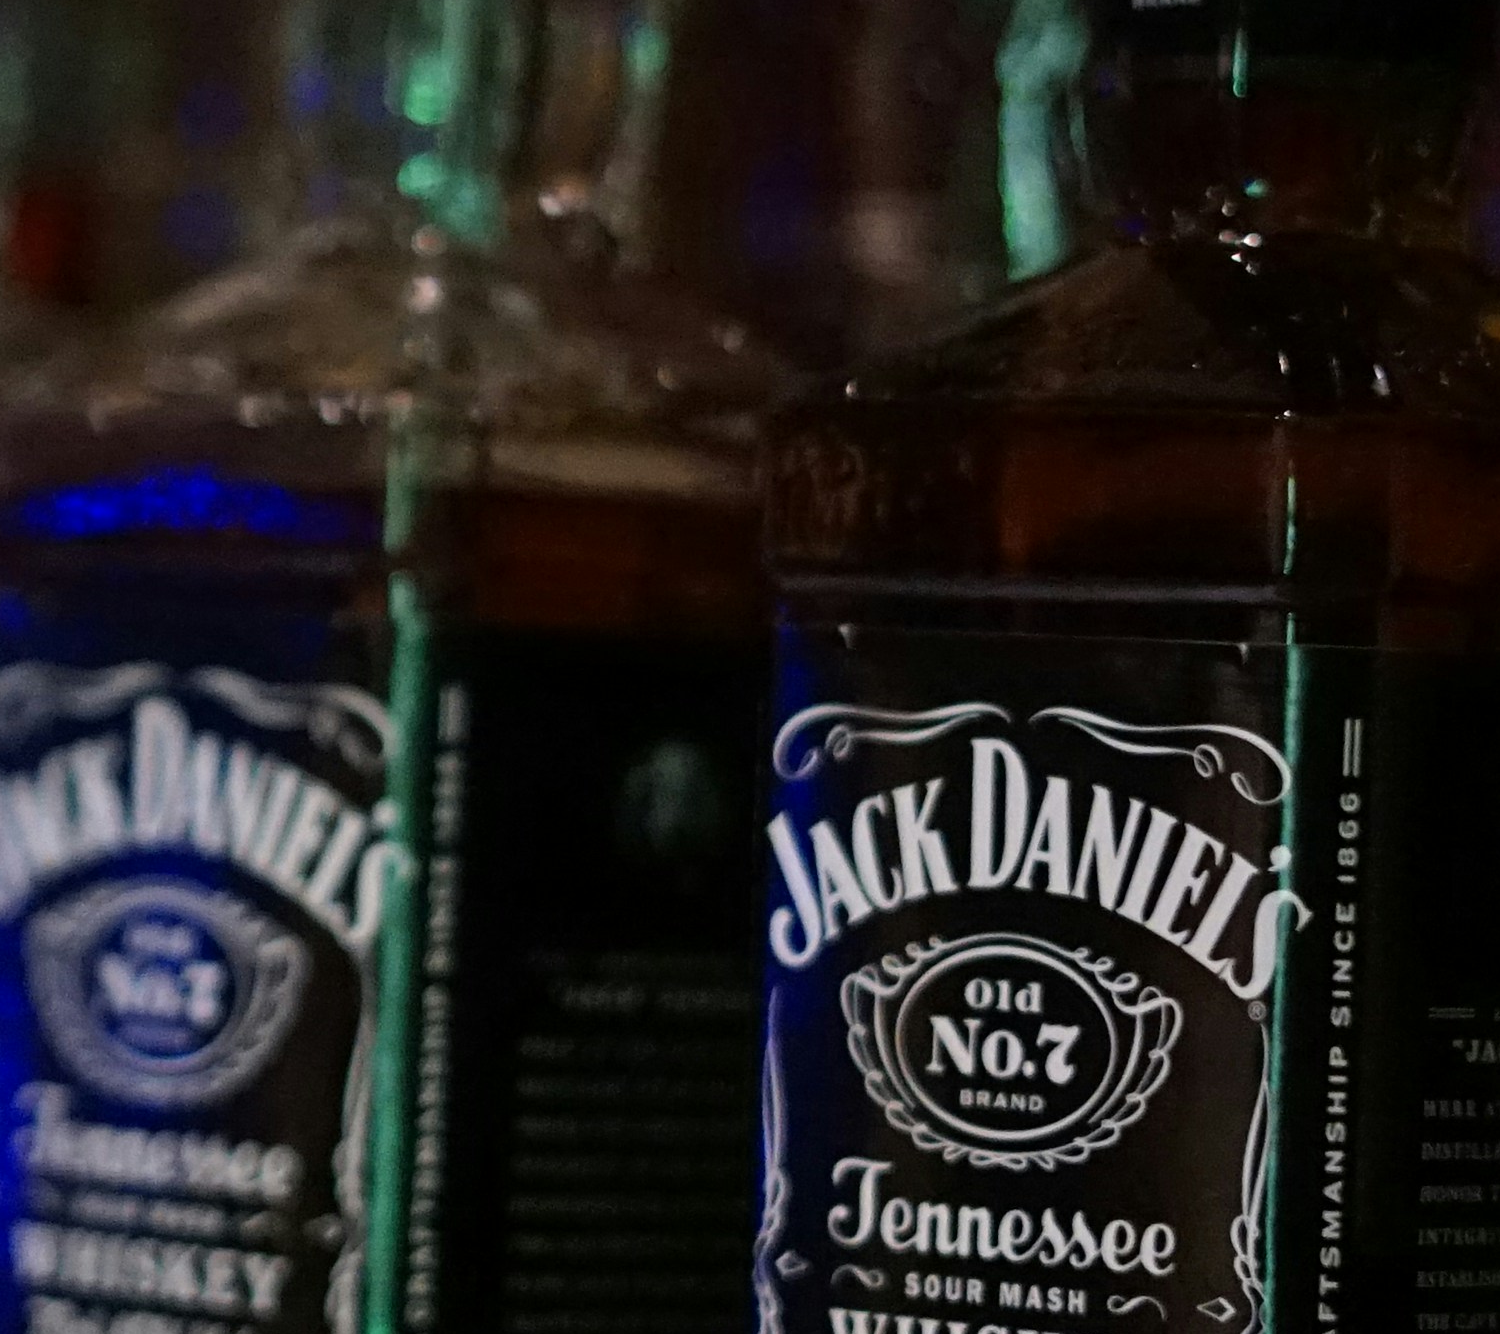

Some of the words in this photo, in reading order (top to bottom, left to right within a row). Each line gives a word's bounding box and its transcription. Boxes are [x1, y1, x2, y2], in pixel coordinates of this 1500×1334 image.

[766, 777, 960, 967] JACK
[966, 737, 1314, 1001] DANIEL'S
[1336, 790, 1363, 885] 1866
[964, 977, 1043, 1015] Old
[1329, 901, 1358, 1029] SINCE
[924, 1014, 1081, 1086] No.7
[958, 1089, 1046, 1113] BRAND
[826, 1156, 1177, 1277] Tennessee
[903, 1270, 985, 1306] SOUR
[999, 1281, 1089, 1316] MASH
